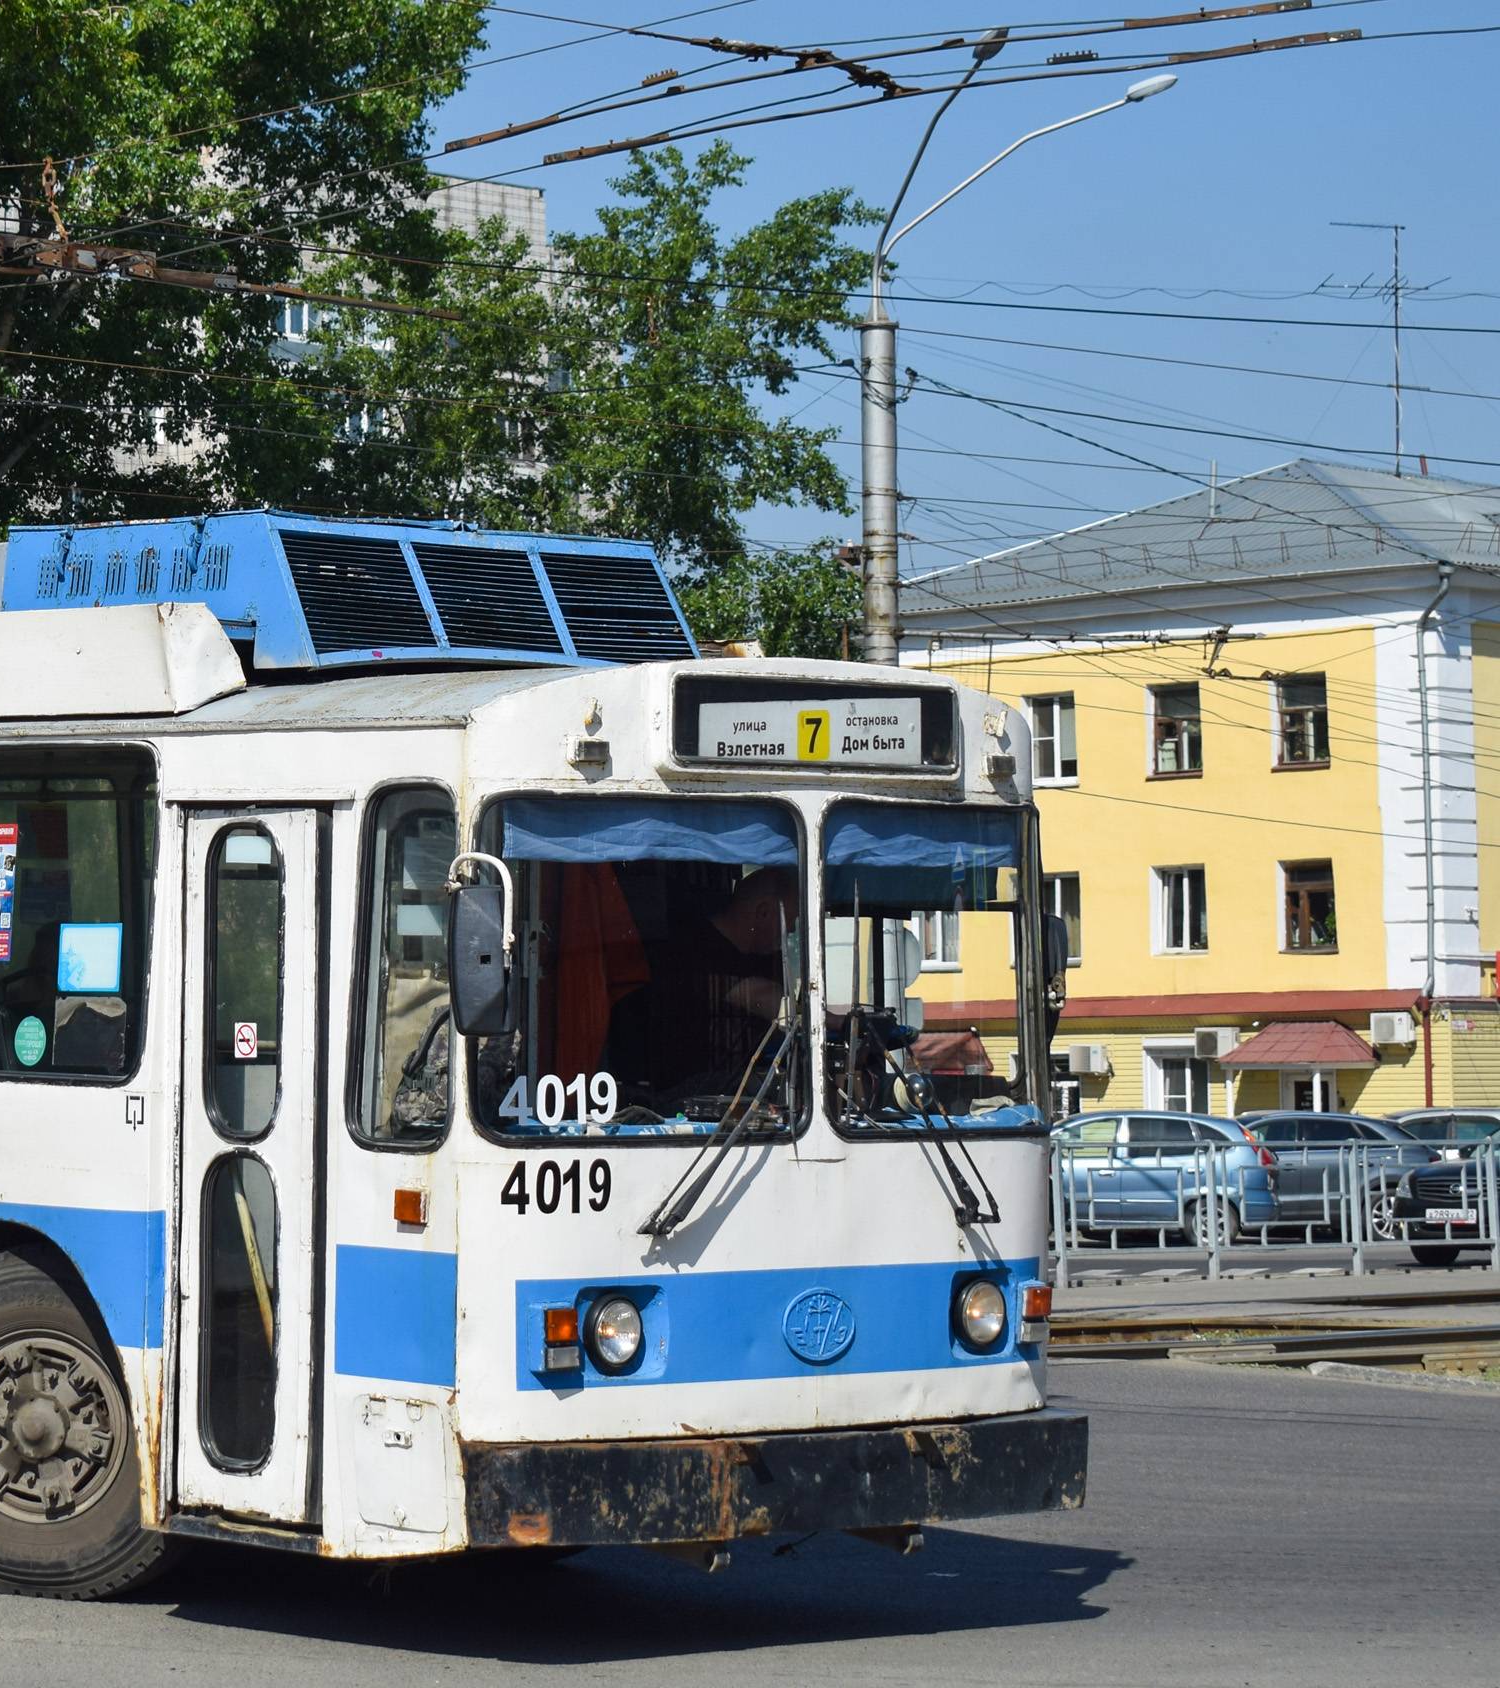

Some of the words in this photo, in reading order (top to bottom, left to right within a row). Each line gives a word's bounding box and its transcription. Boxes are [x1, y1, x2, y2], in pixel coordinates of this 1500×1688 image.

[733, 721, 767, 735] улица
[846, 716, 899, 726] остановка
[805, 717, 822, 753] 7
[842, 736, 869, 754] Дом
[873, 735, 905, 750] быта
[717, 741, 785, 757] Взлетная
[498, 1071, 618, 1126] 4019
[500, 1158, 612, 1215] 4019
